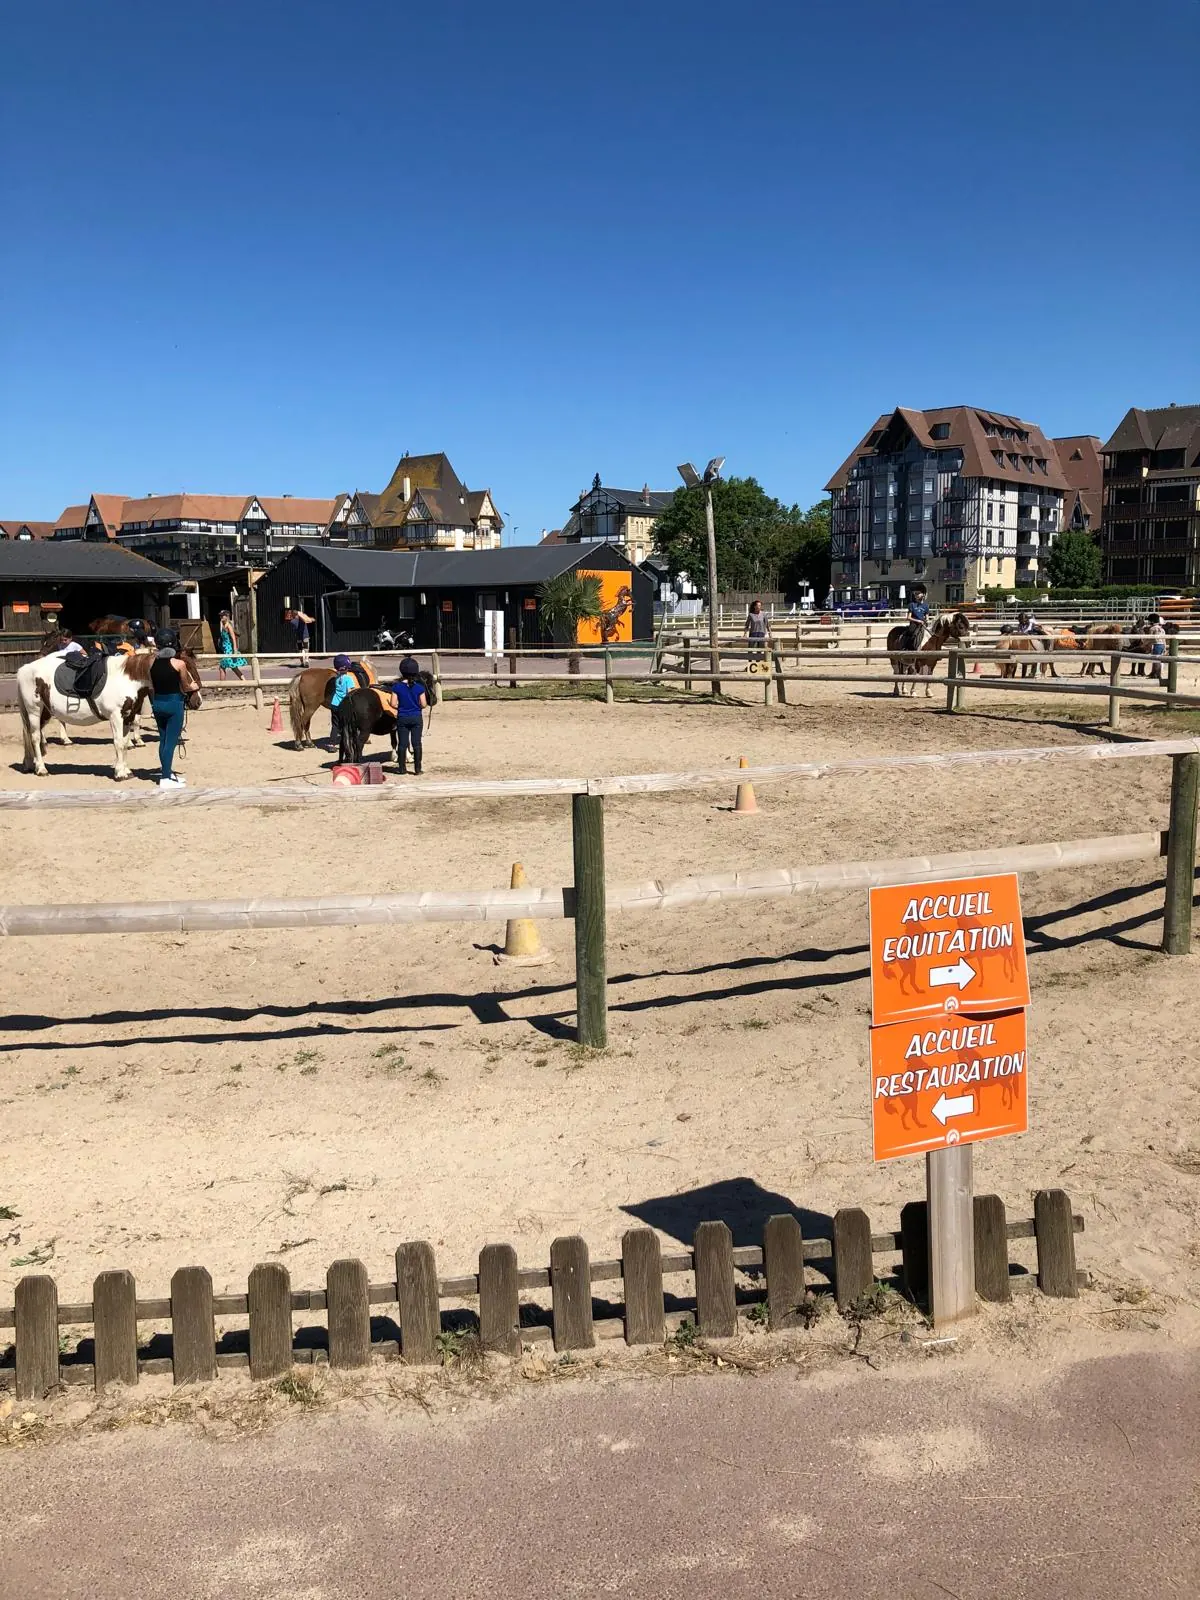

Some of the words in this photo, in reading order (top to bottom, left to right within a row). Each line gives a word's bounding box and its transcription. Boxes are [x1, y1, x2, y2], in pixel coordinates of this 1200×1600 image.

[749, 663, 758, 673] C
[901, 891, 993, 924] ACCUEIL
[882, 922, 1014, 963] EQUITATION
[904, 1023, 997, 1059] ACCUEIL
[874, 1051, 1025, 1099] RESTAURATION
